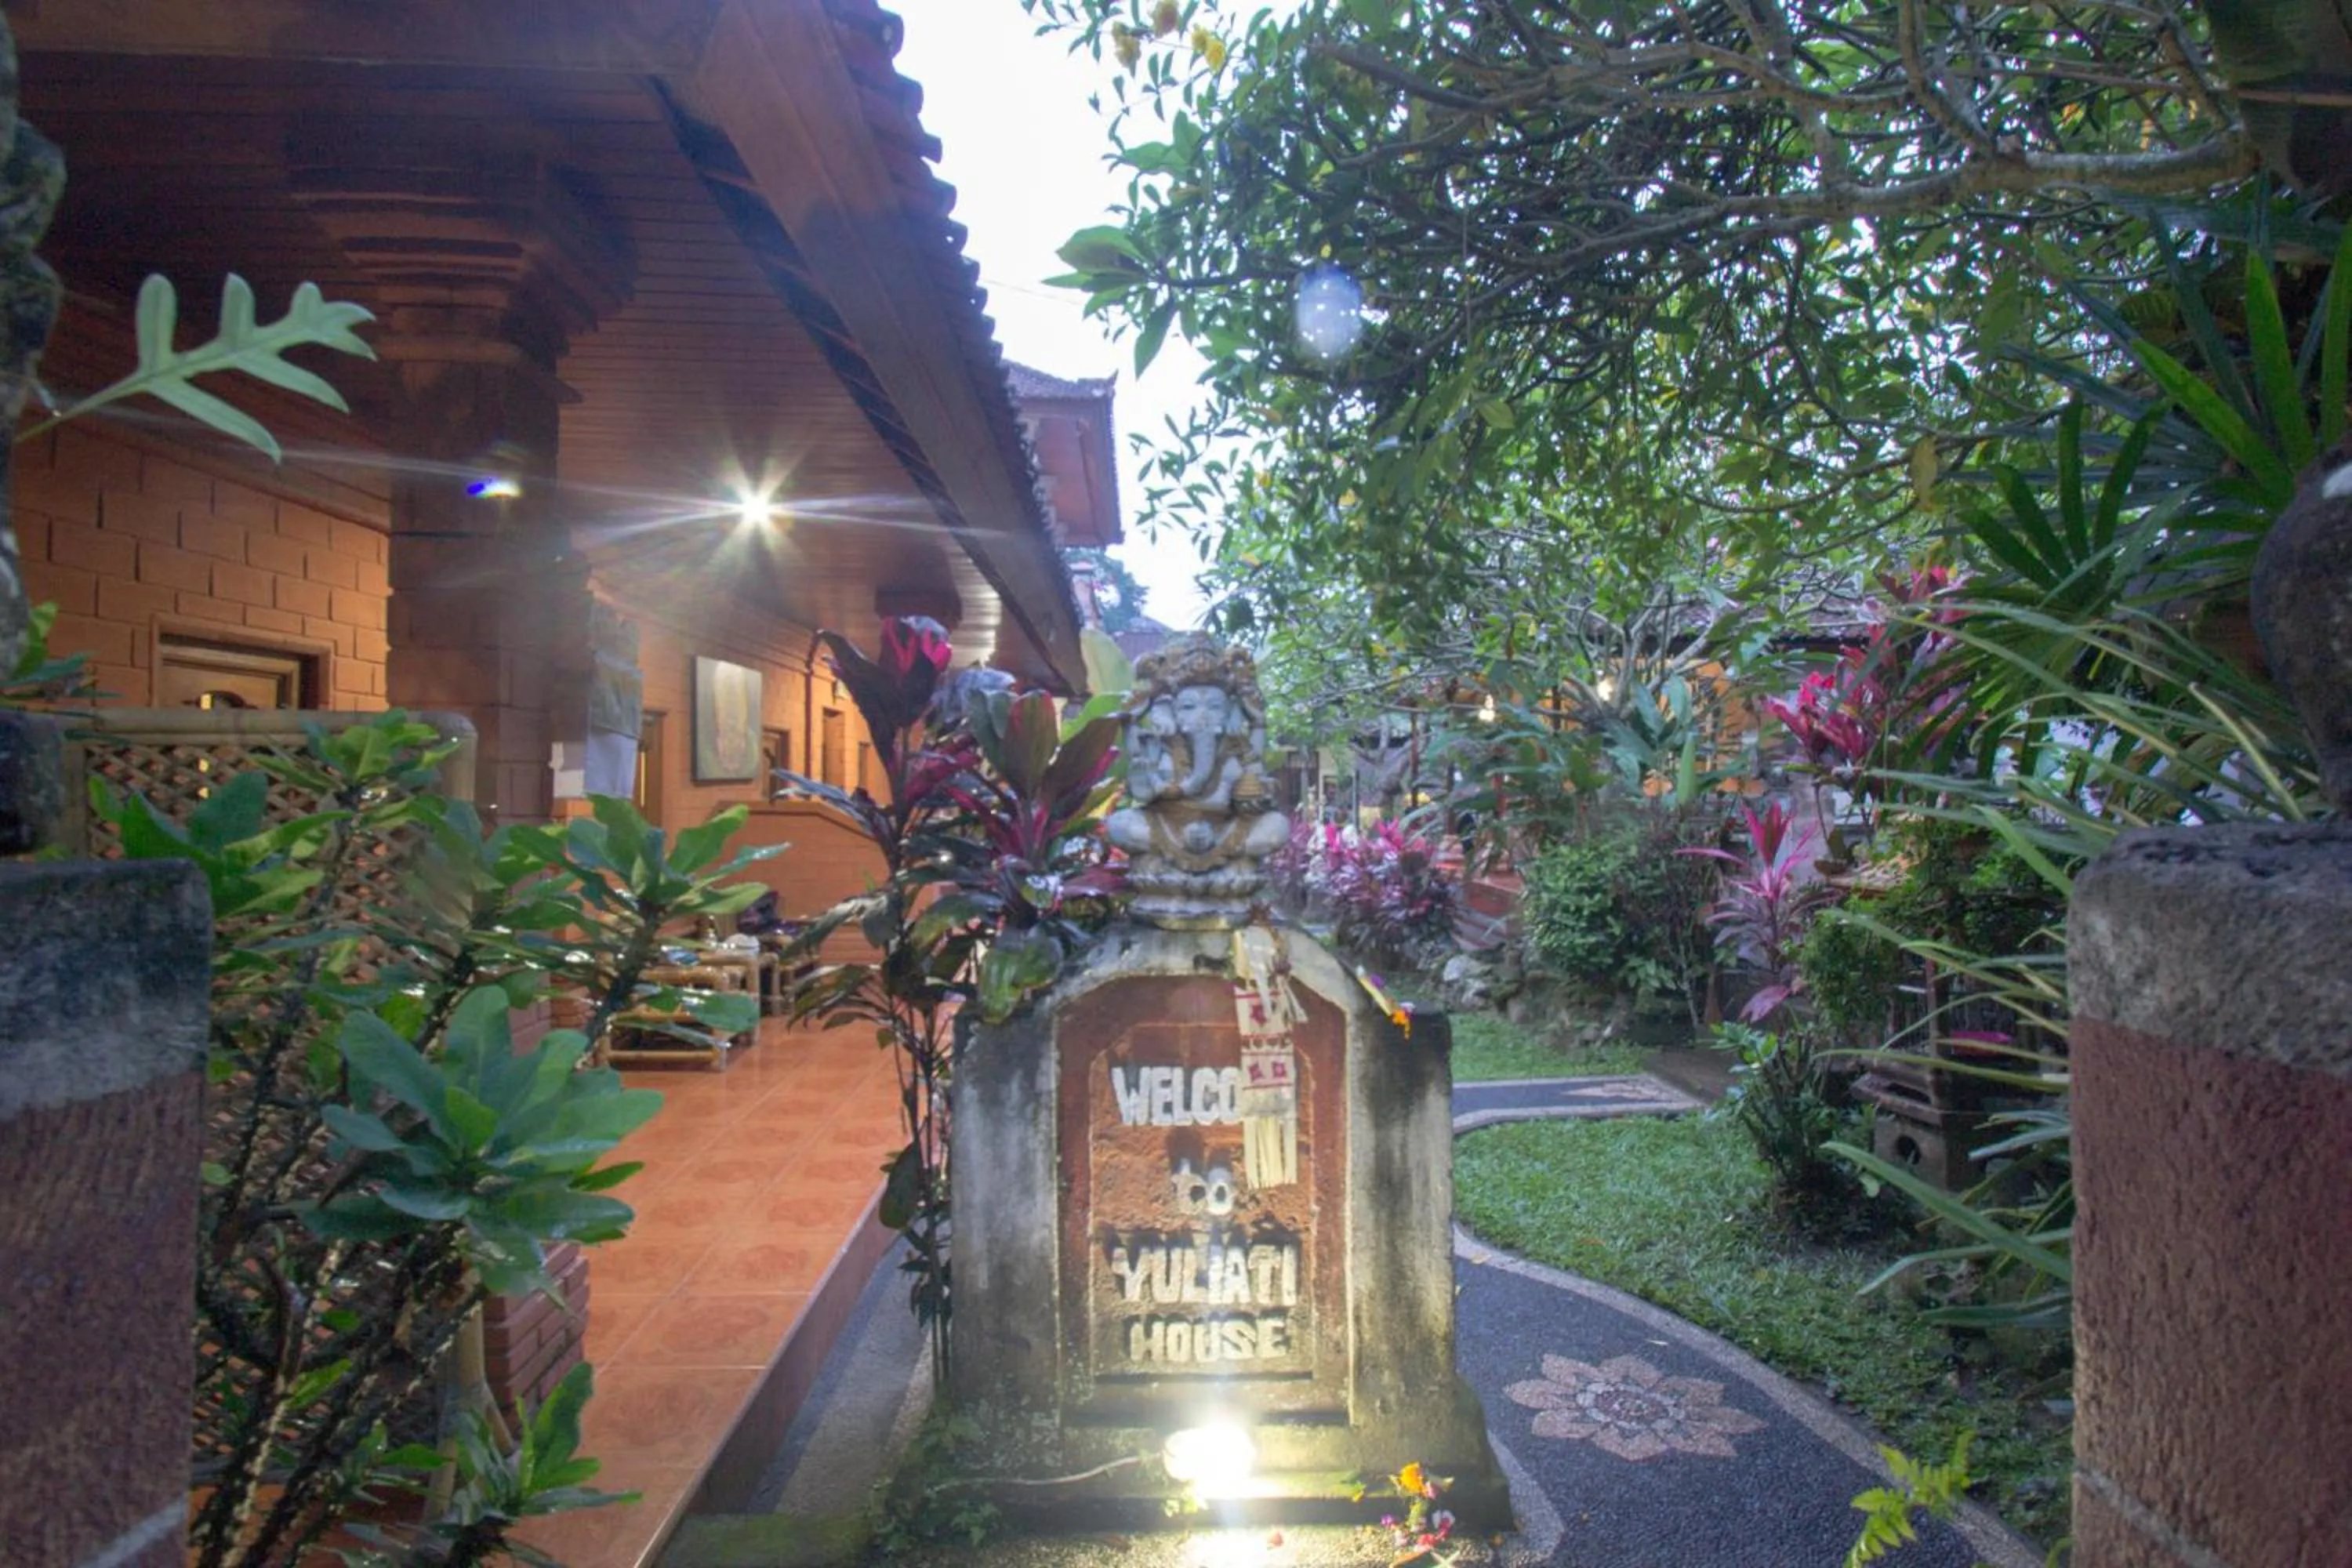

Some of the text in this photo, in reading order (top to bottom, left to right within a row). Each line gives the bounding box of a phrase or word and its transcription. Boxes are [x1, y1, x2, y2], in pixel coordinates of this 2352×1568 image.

[1111, 1066, 1243, 1127] WELCO
[1111, 1244, 1297, 1305] YULIATI
[1130, 1318, 1288, 1363] HOUSE
